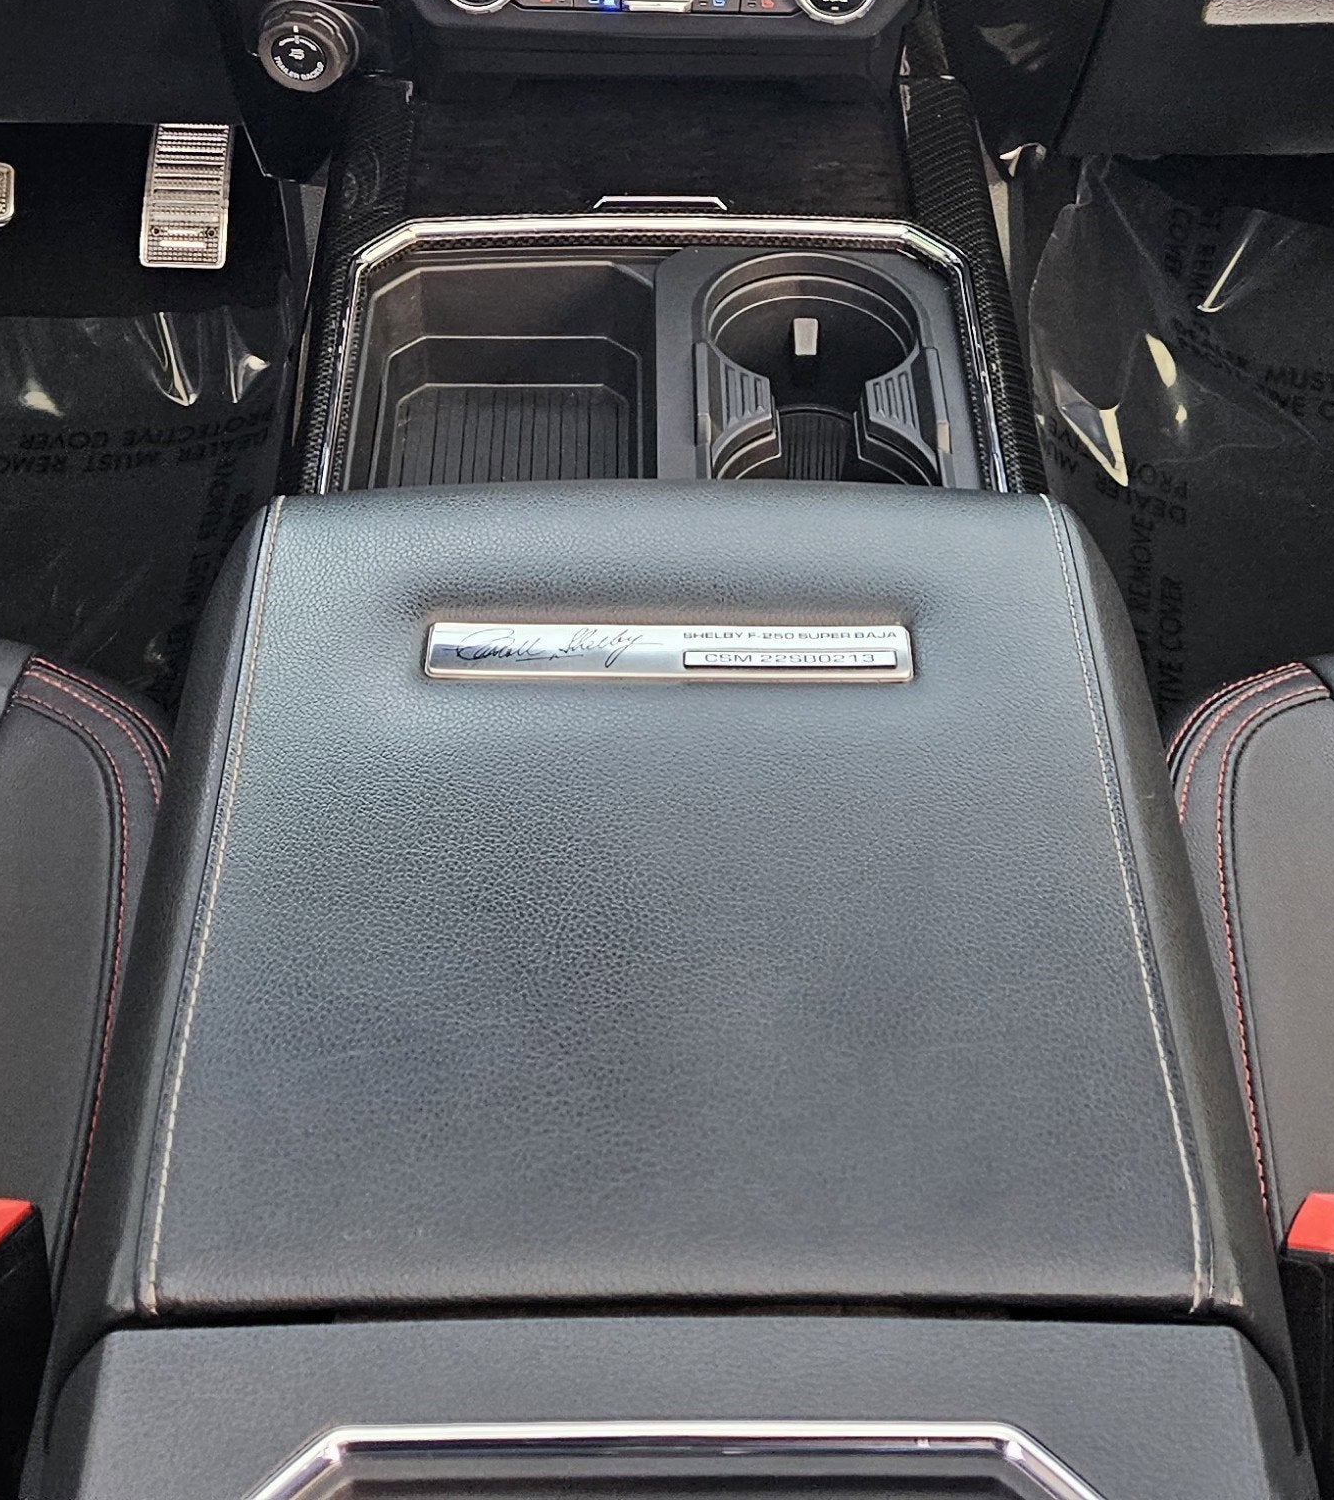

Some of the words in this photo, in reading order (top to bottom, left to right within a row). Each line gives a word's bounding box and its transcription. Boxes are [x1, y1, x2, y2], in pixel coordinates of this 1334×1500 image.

[683, 631, 743, 640] SHELBY
[748, 631, 795, 640] F-250
[798, 631, 851, 639] SUPER
[854, 631, 898, 639] BAJA
[704, 653, 753, 664] CSM
[760, 653, 876, 664] 22SB0213
